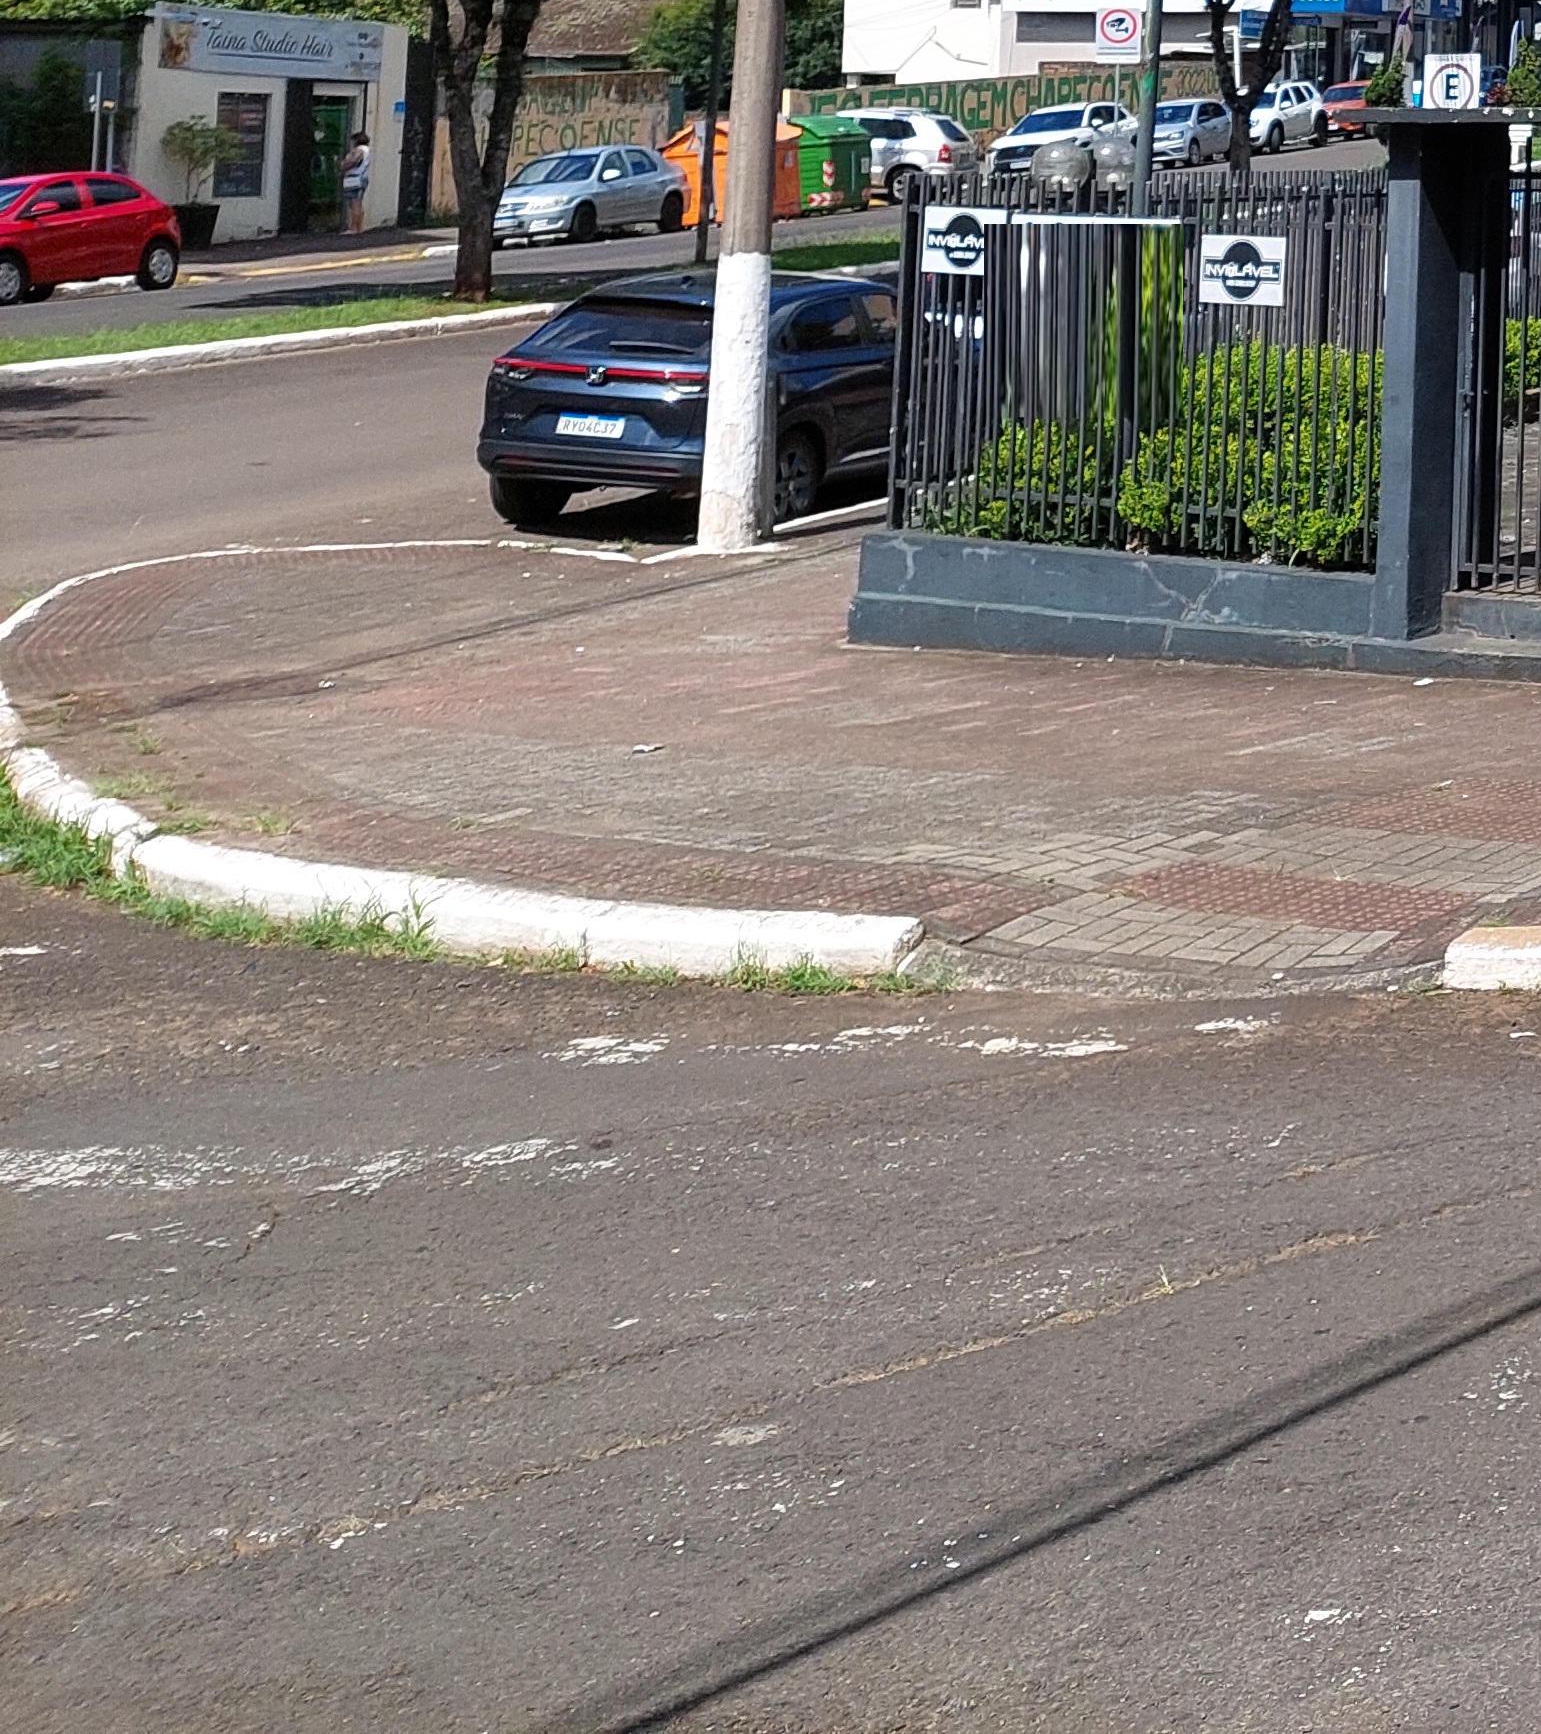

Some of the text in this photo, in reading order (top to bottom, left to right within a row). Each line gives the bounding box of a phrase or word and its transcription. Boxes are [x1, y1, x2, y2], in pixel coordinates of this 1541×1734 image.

[252, 29, 299, 54] Studio
[300, 35, 334, 59] Hair
[1445, 74, 1459, 100] E
